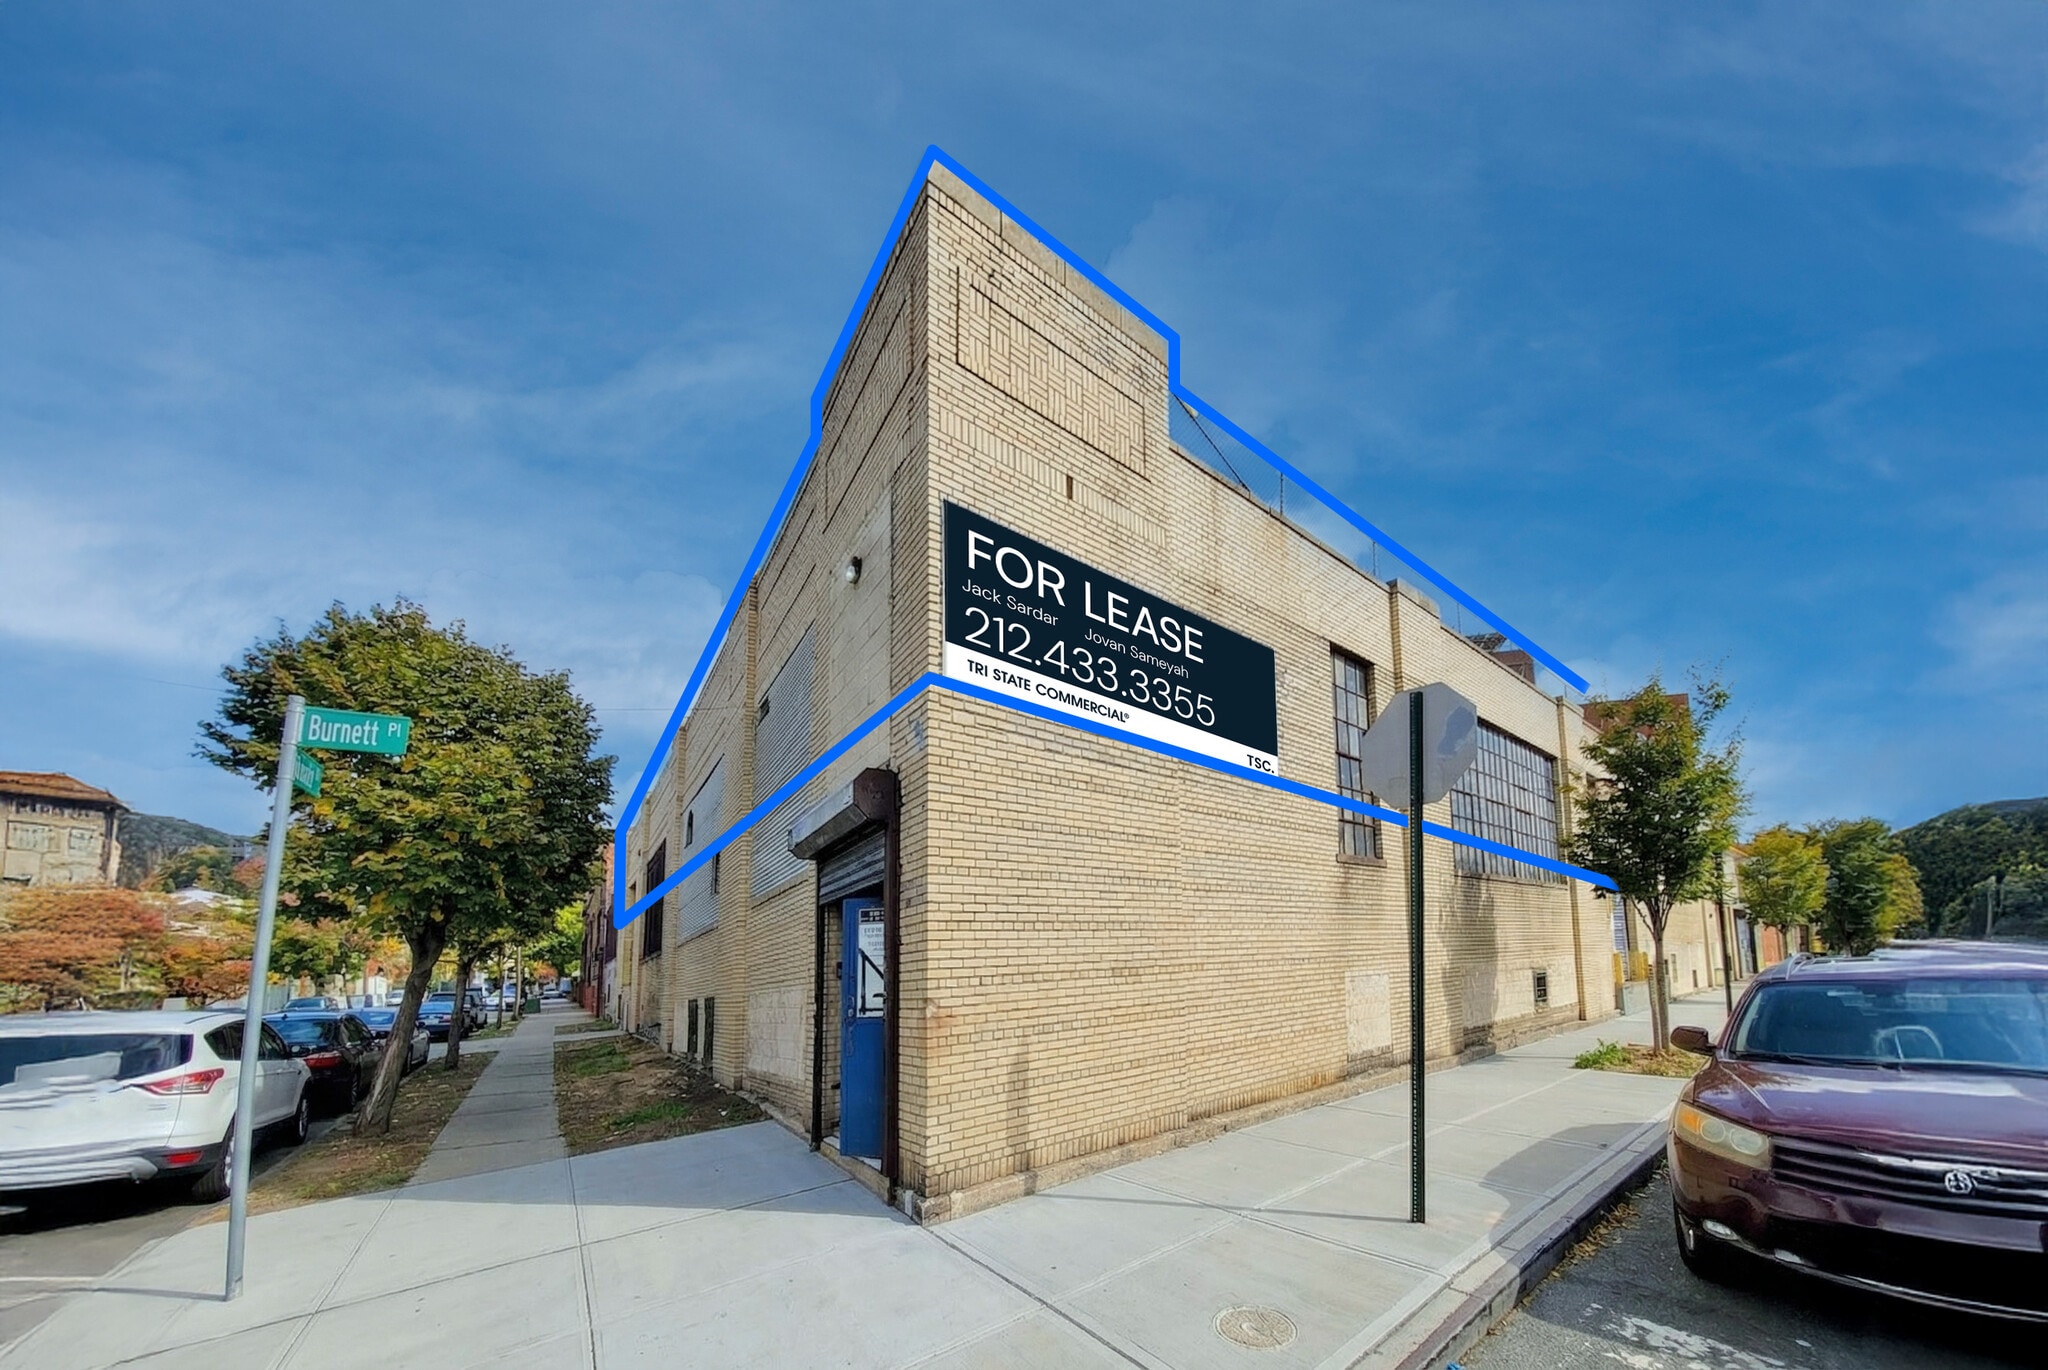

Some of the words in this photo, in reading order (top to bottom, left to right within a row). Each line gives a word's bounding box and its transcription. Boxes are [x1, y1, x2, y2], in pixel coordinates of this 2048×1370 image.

[962, 579, 1002, 605] Jack
[1006, 595, 1059, 626] Sardar
[968, 529, 1066, 607] FOR
[1084, 580, 1204, 664] LEASE
[965, 607, 1216, 727] 212.433.3355
[967, 659, 988, 677] TRI
[993, 668, 1031, 691] STATE
[1084, 628, 1126, 654] Jovan
[1130, 645, 1189, 679] Sameyah
[308, 714, 379, 746] Burnett
[387, 722, 401, 738] Pl
[1246, 754, 1275, 774] TSC.
